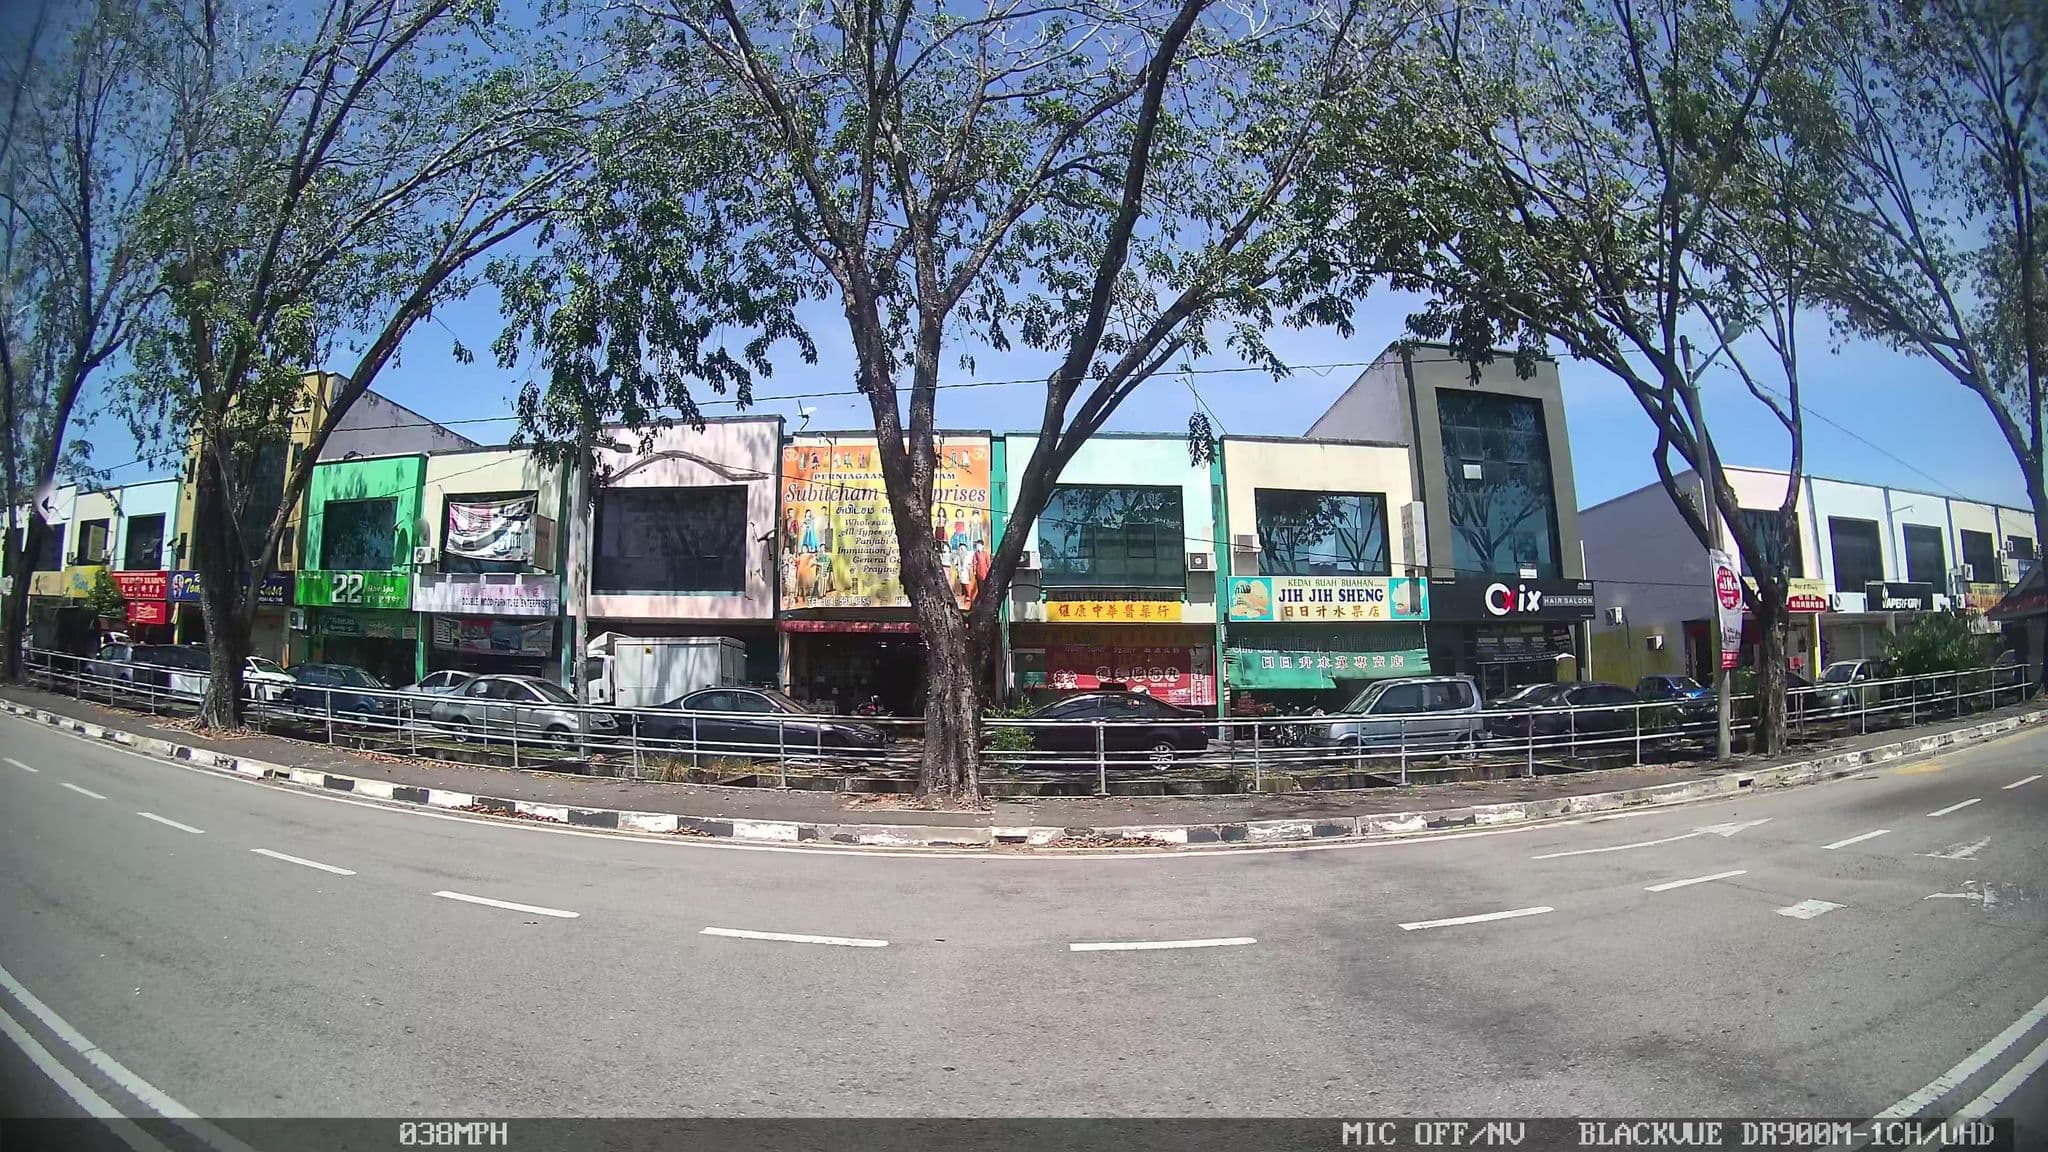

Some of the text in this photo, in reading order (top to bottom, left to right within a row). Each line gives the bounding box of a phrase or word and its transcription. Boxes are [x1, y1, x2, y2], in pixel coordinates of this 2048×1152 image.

[786, 483, 878, 502] Subitcham
[331, 573, 364, 603] 22
[1287, 579, 1311, 587] KEDAI
[1315, 579, 1337, 587] BUAH
[1278, 589, 1384, 602] JIH JIH SHENG
